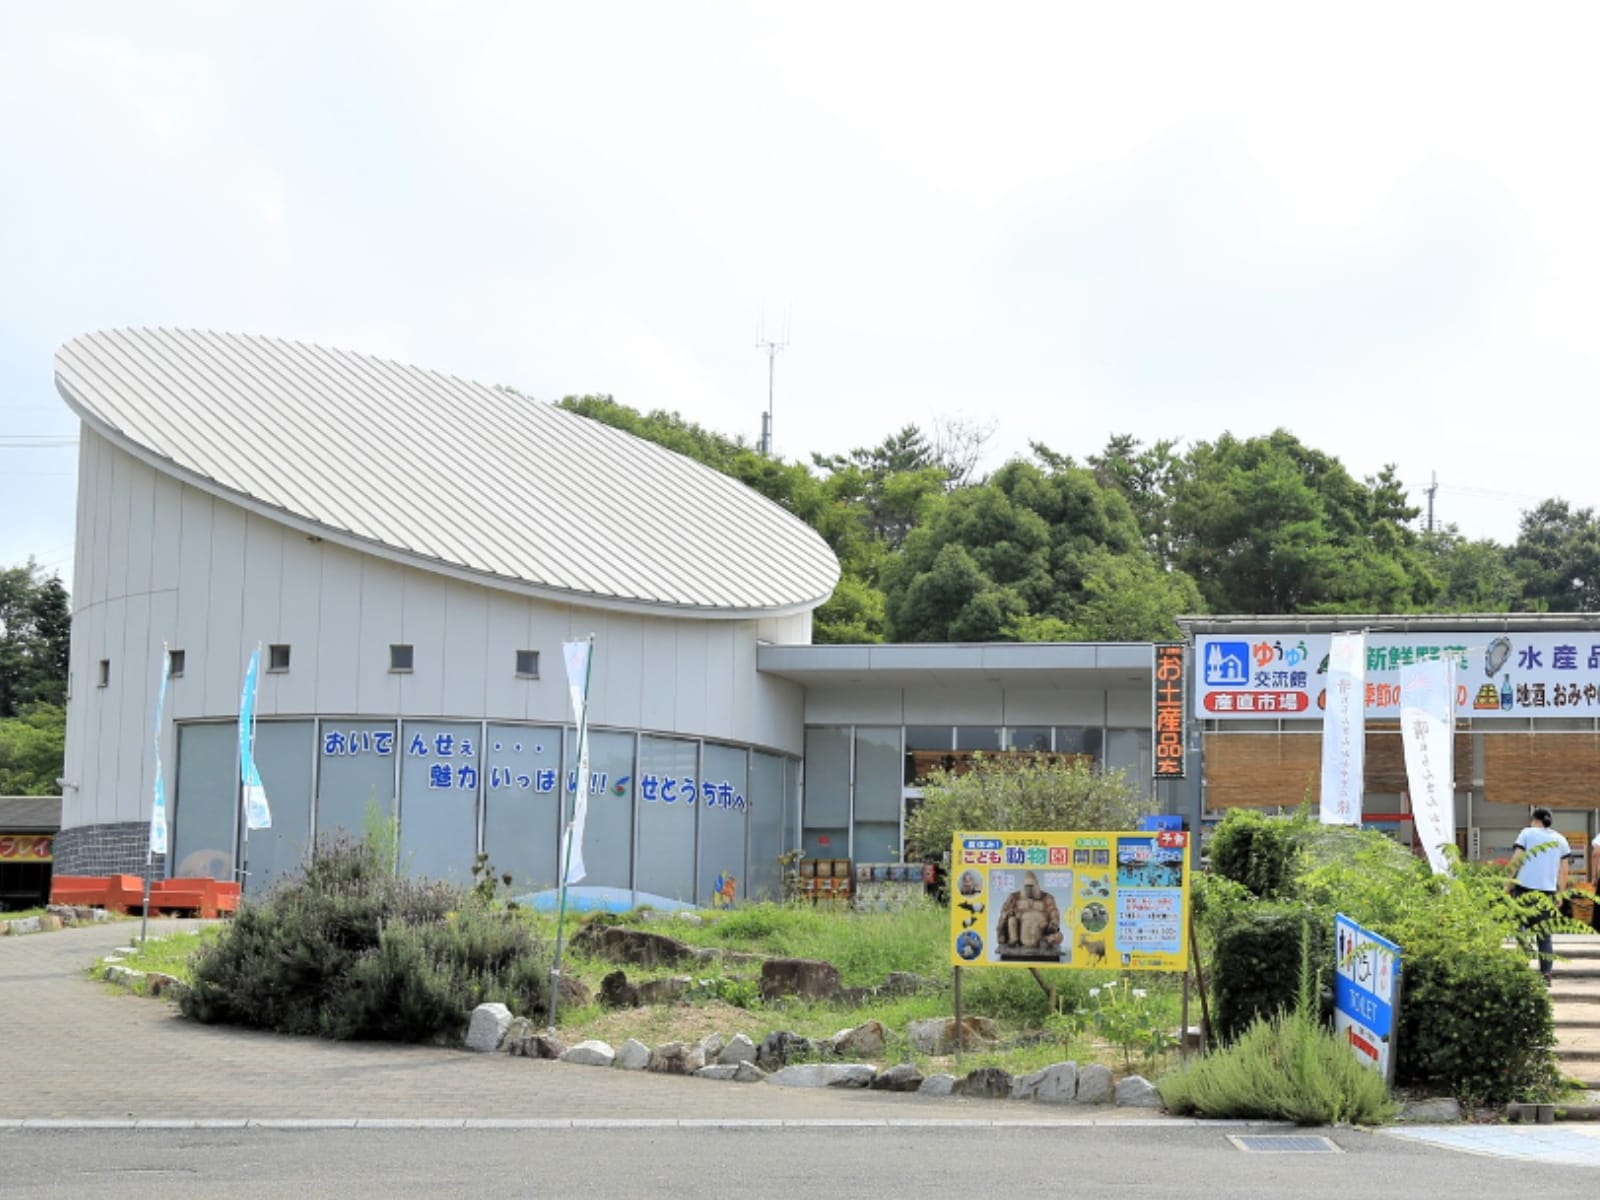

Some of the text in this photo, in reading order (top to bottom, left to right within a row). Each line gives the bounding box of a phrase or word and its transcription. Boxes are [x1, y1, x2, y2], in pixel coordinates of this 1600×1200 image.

[1252, 640, 1308, 667] ゆうゆう
[1254, 671, 1307, 688] 交流館
[1214, 692, 1298, 710] 産直市場
[1516, 683, 1600, 707] 地酒、おみや
[1349, 989, 1378, 1023] TOILET
